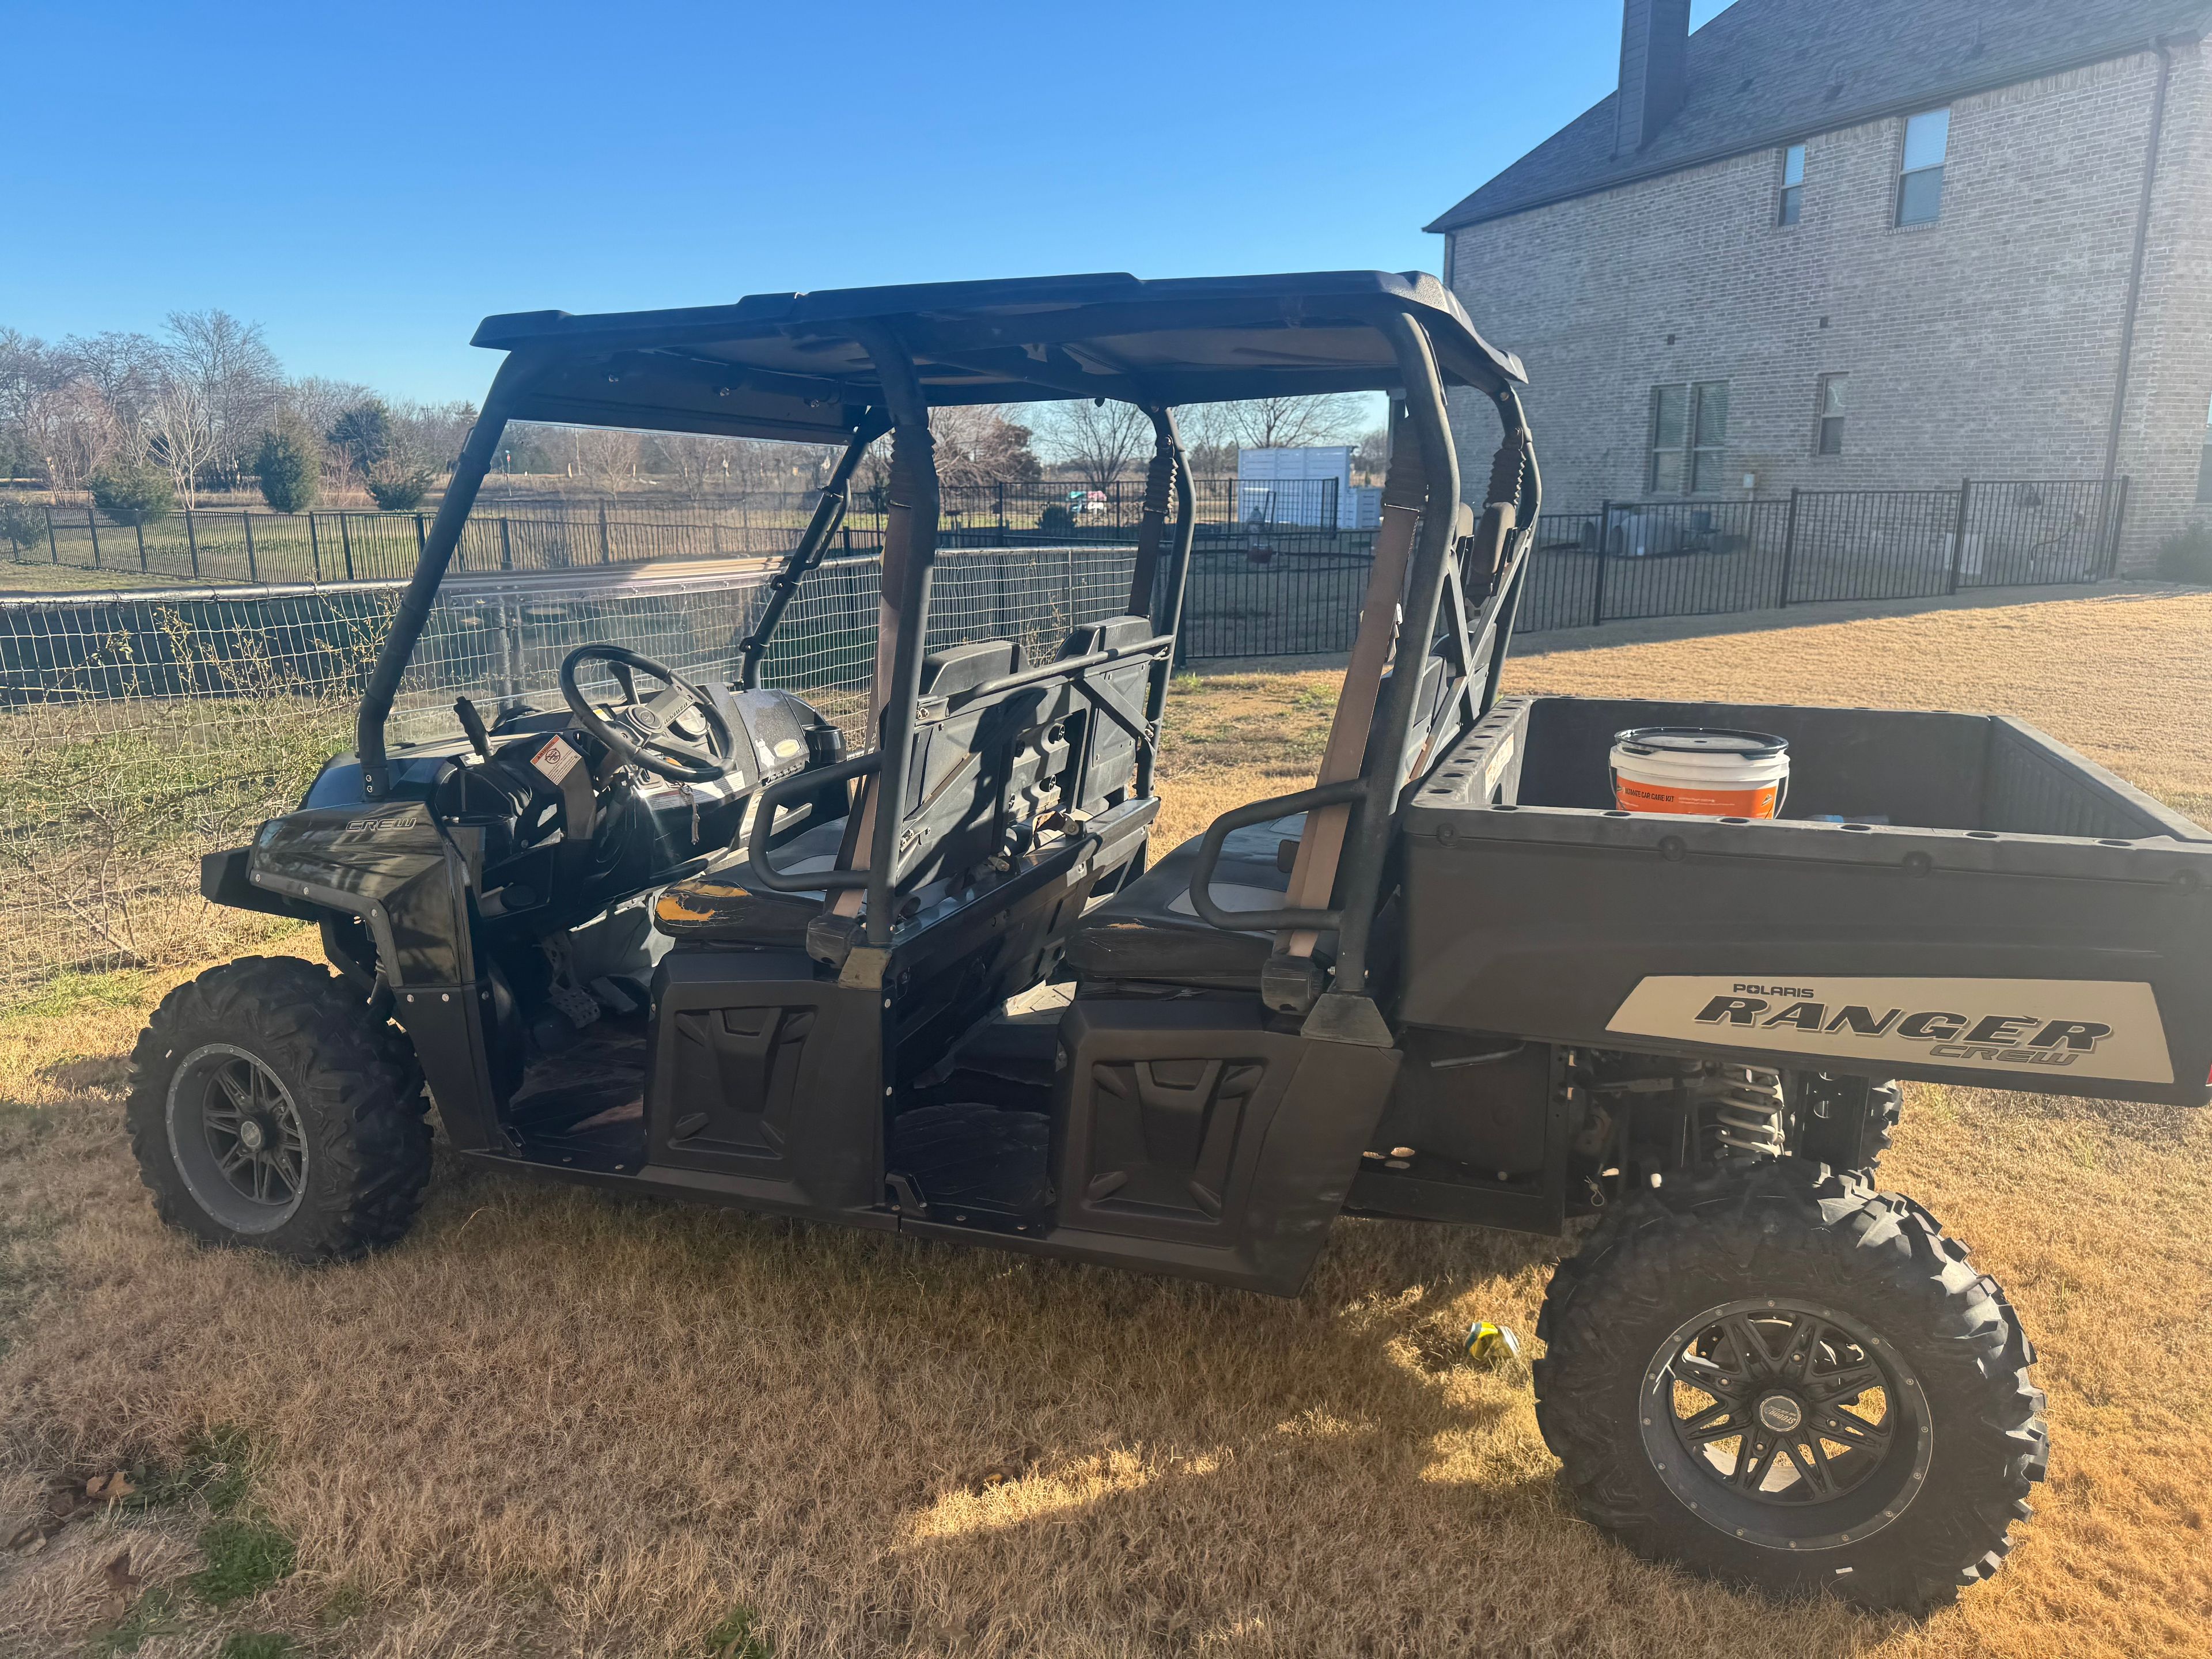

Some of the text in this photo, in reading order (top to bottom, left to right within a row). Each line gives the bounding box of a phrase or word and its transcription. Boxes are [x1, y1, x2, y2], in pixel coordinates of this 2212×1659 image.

[1651, 793, 1665, 801] CARE
[346, 817, 416, 832] CREW
[1733, 983, 1814, 998] POLARIS
[1694, 995, 2113, 1052] RANGER
[1930, 1044, 2078, 1066] CREW
